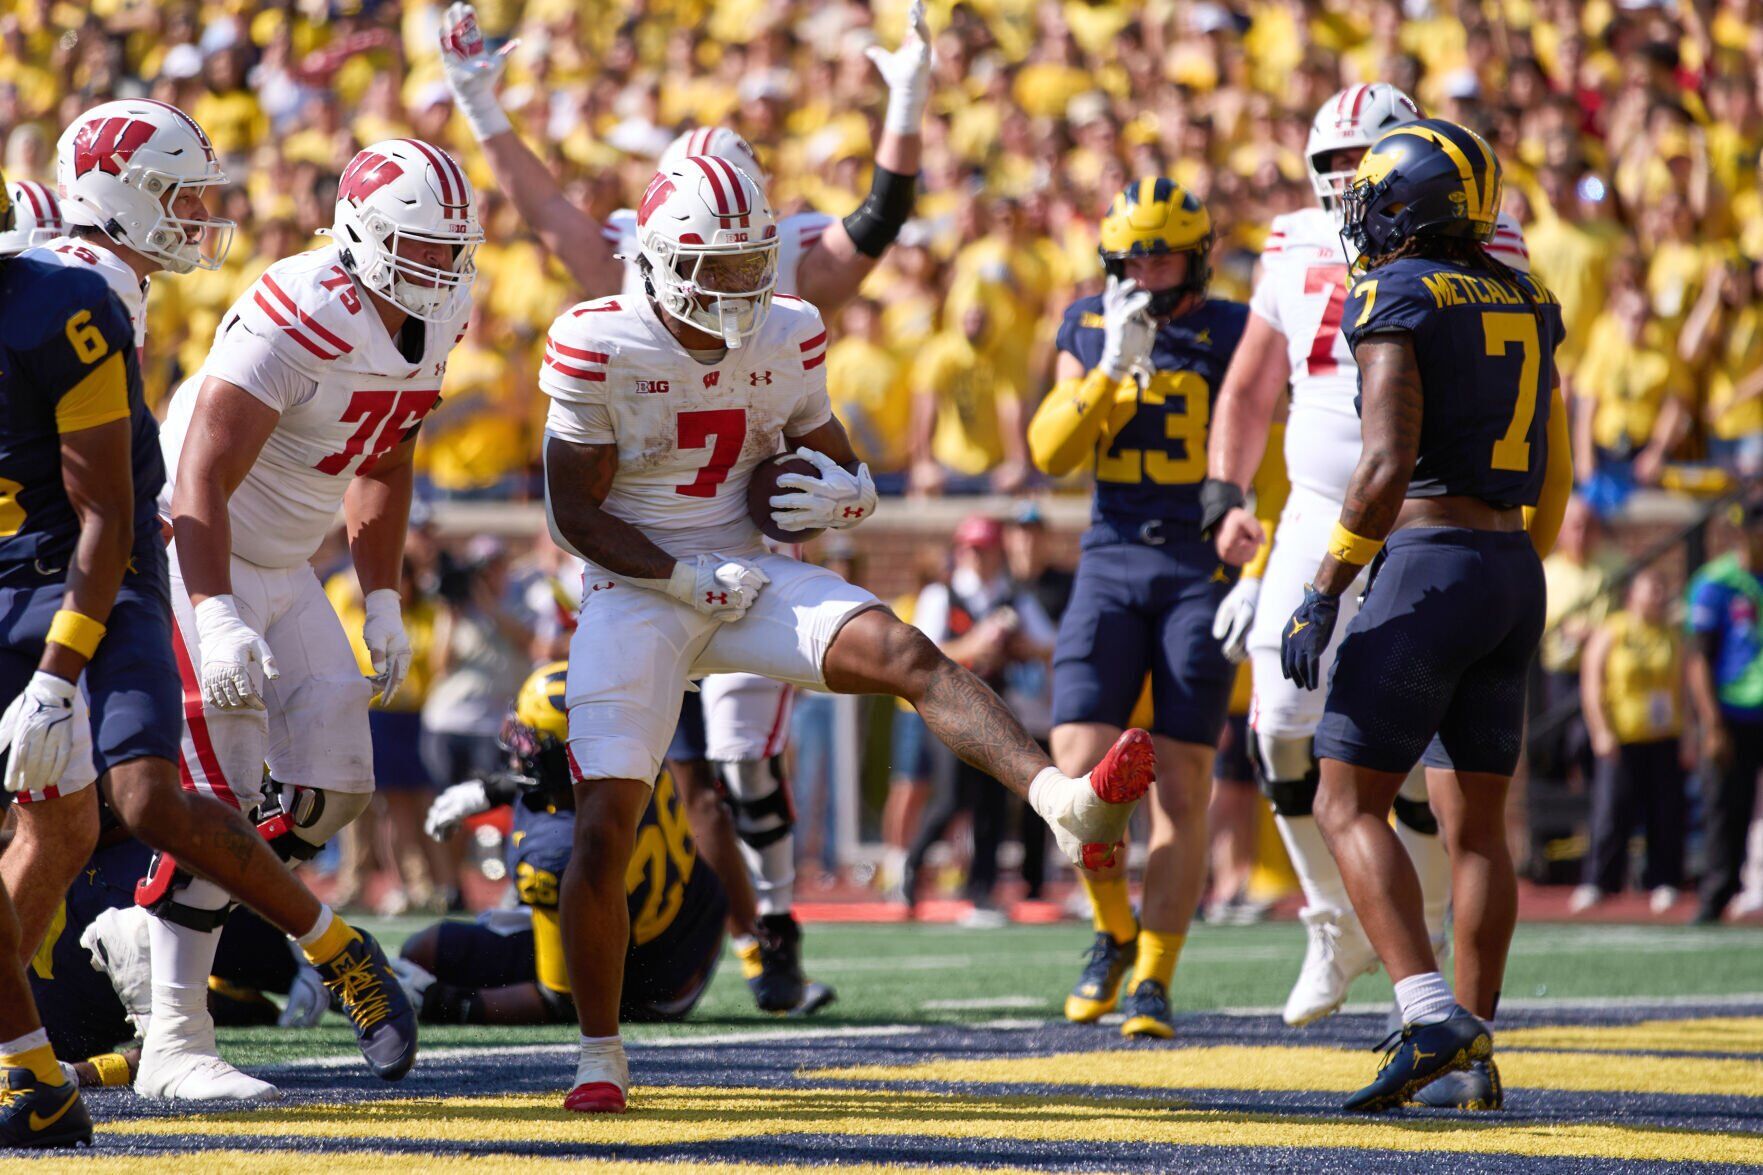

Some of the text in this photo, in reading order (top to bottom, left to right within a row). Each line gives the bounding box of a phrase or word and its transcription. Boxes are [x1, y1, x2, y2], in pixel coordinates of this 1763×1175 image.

[320, 265, 362, 316] 75
[572, 300, 622, 318] 7
[1354, 279, 1379, 328] 7
[65, 309, 109, 365] 6
[1481, 311, 1541, 472] 7
[675, 408, 747, 498] 7
